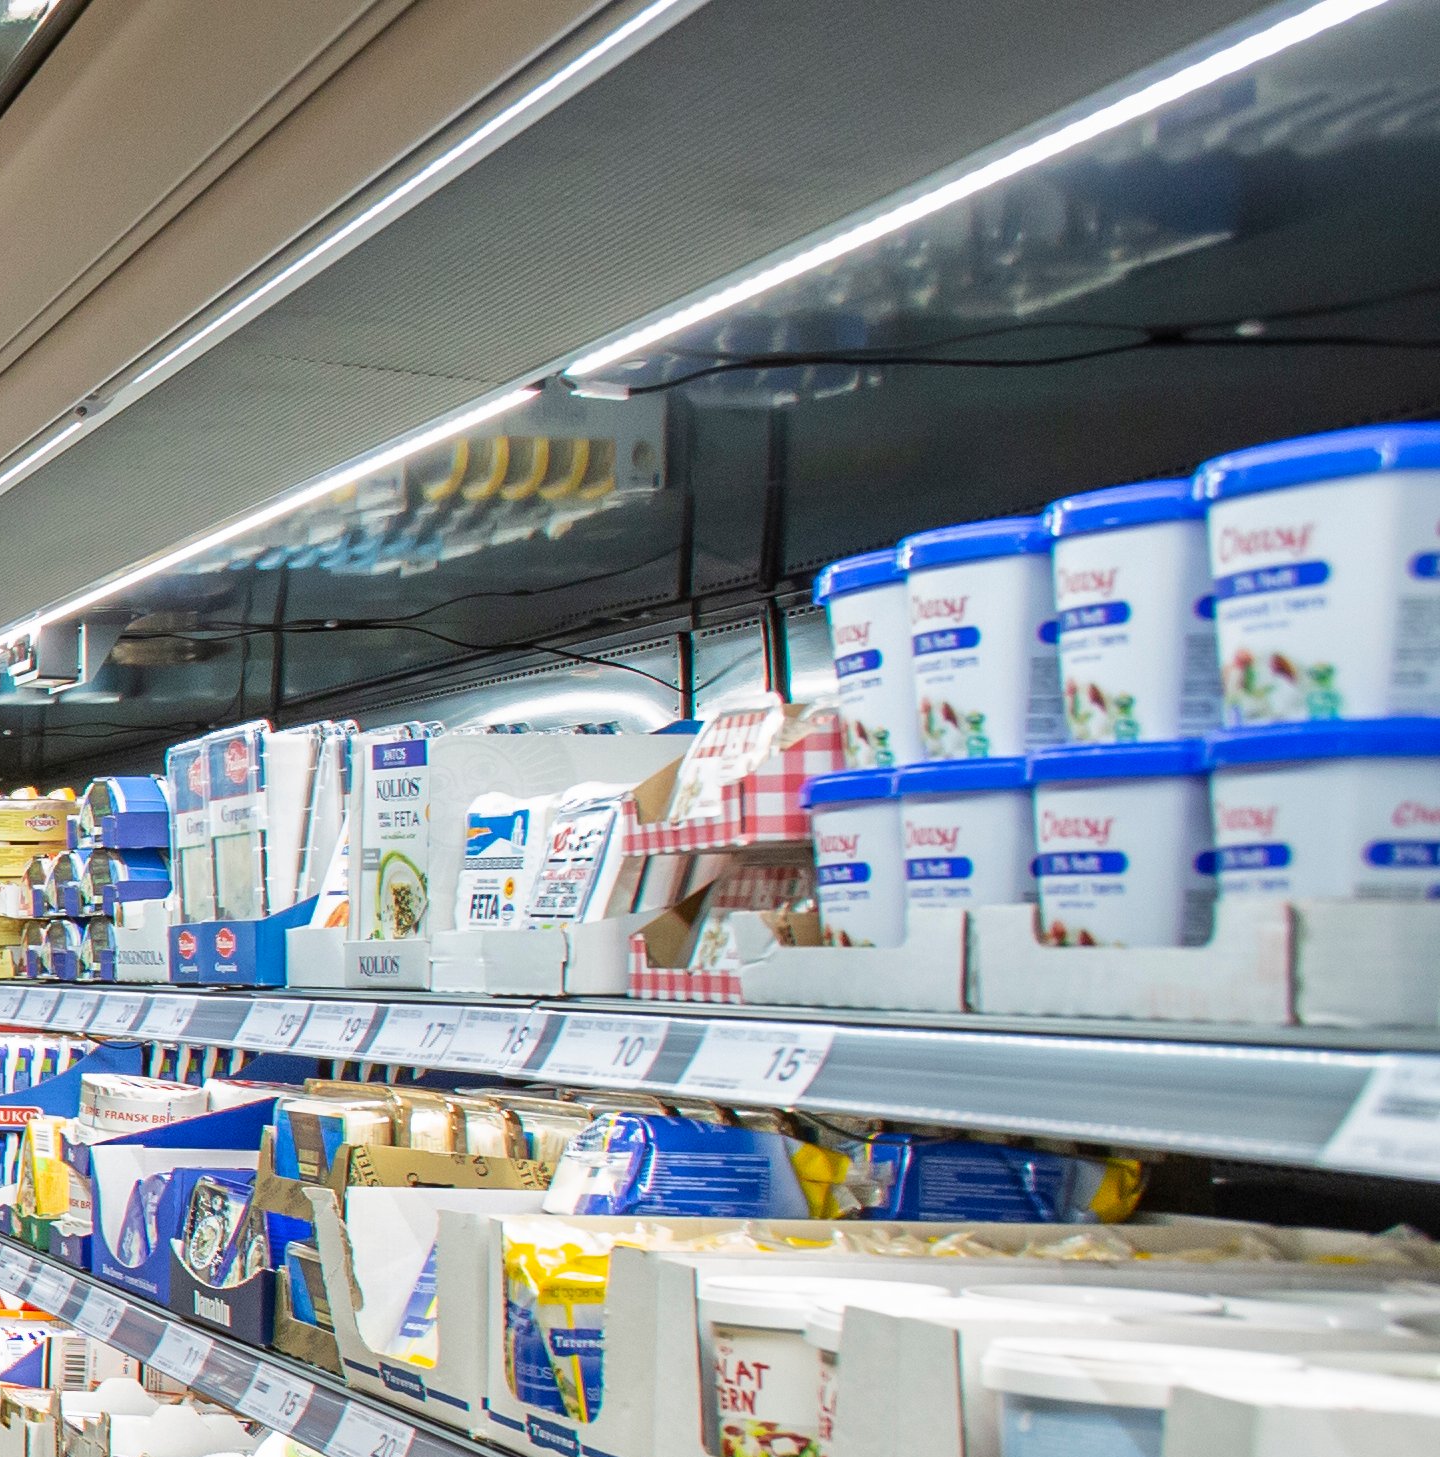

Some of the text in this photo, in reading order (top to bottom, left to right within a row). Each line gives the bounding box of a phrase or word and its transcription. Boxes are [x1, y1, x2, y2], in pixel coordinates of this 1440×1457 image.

[394, 810, 421, 828] FETA
[1391, 800, 1440, 830] Che
[469, 892, 501, 921] FETA
[422, 1021, 446, 1047] 17
[500, 1025, 525, 1053] 18
[614, 1036, 641, 1069] 10
[768, 1046, 800, 1084] 15
[104, 1110, 150, 1124] FRANSK
[715, 1361, 772, 1391] LAT
[719, 1387, 758, 1415] ERN
